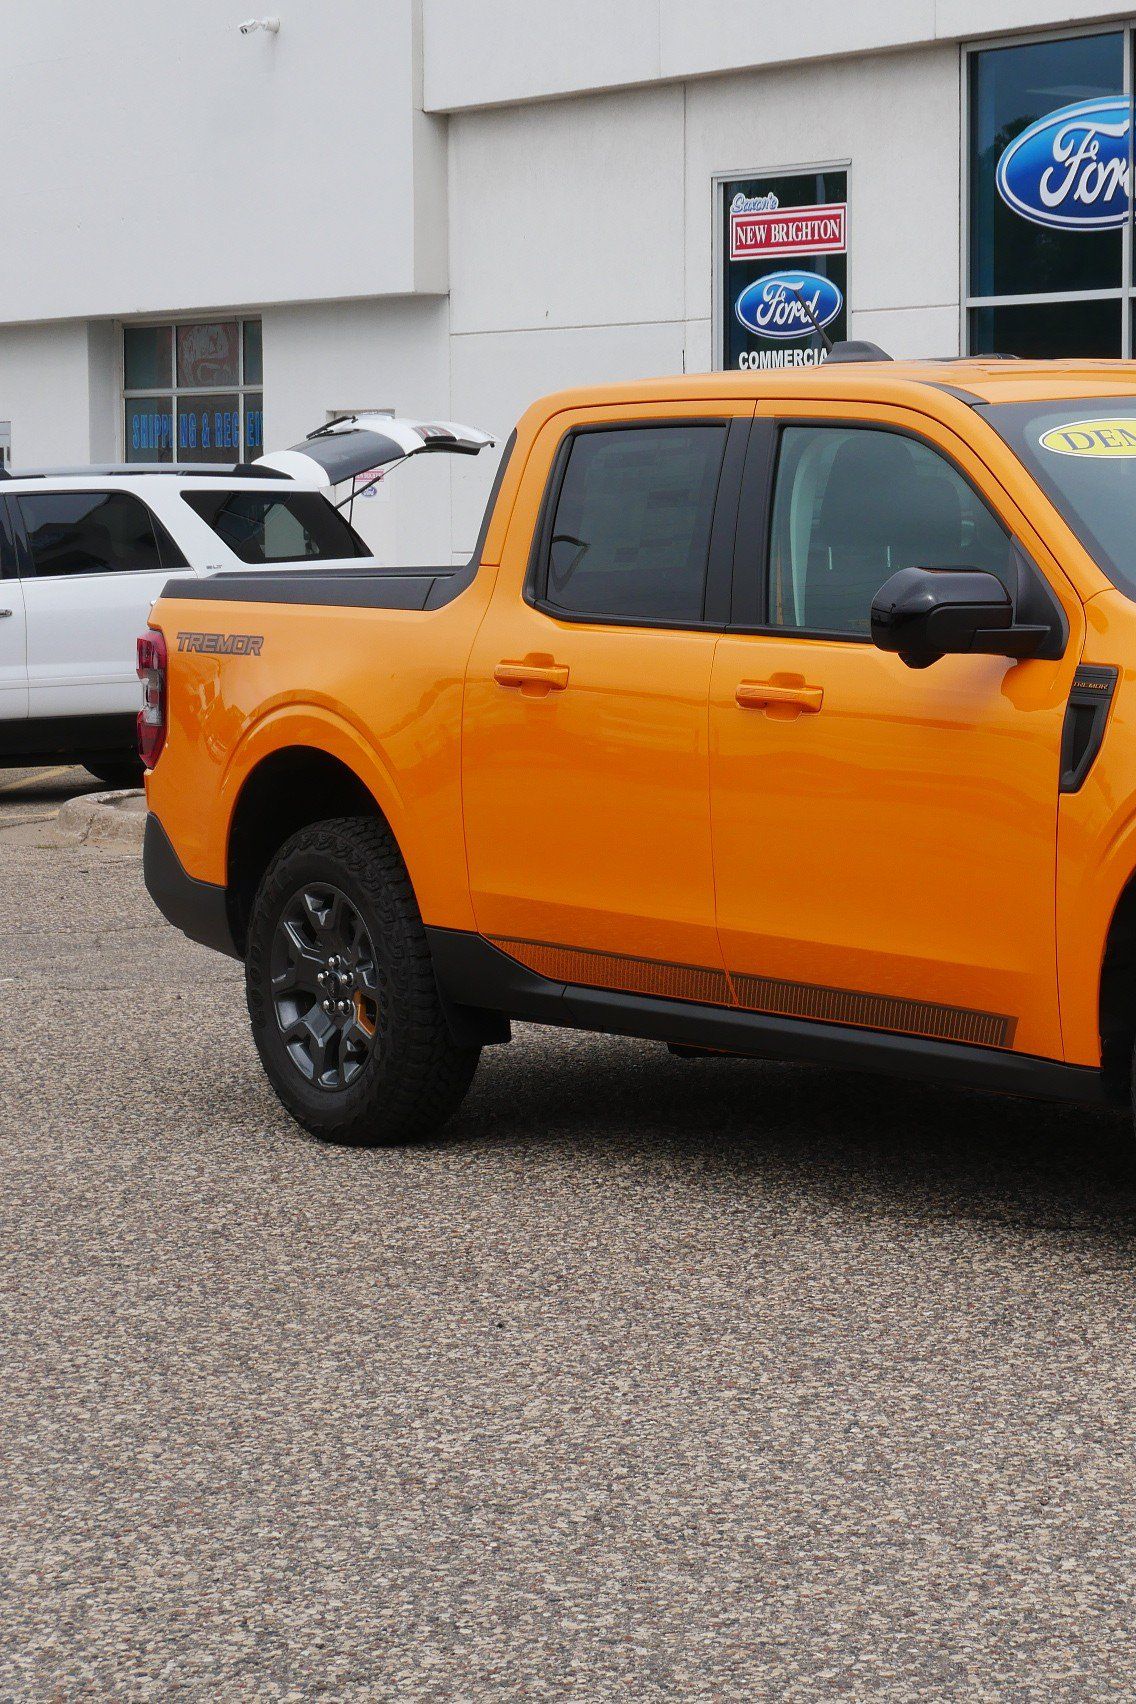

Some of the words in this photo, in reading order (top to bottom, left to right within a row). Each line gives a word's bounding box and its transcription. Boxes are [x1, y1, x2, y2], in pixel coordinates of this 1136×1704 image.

[731, 192, 779, 213] Saxon's
[736, 224, 768, 247] NEW
[770, 218, 841, 243] BRIGHTON
[756, 280, 821, 326] Ford
[132, 413, 198, 449] SHIPPING
[201, 412, 211, 448] &
[214, 411, 264, 448] RECEI
[176, 631, 265, 657] TREMOR
